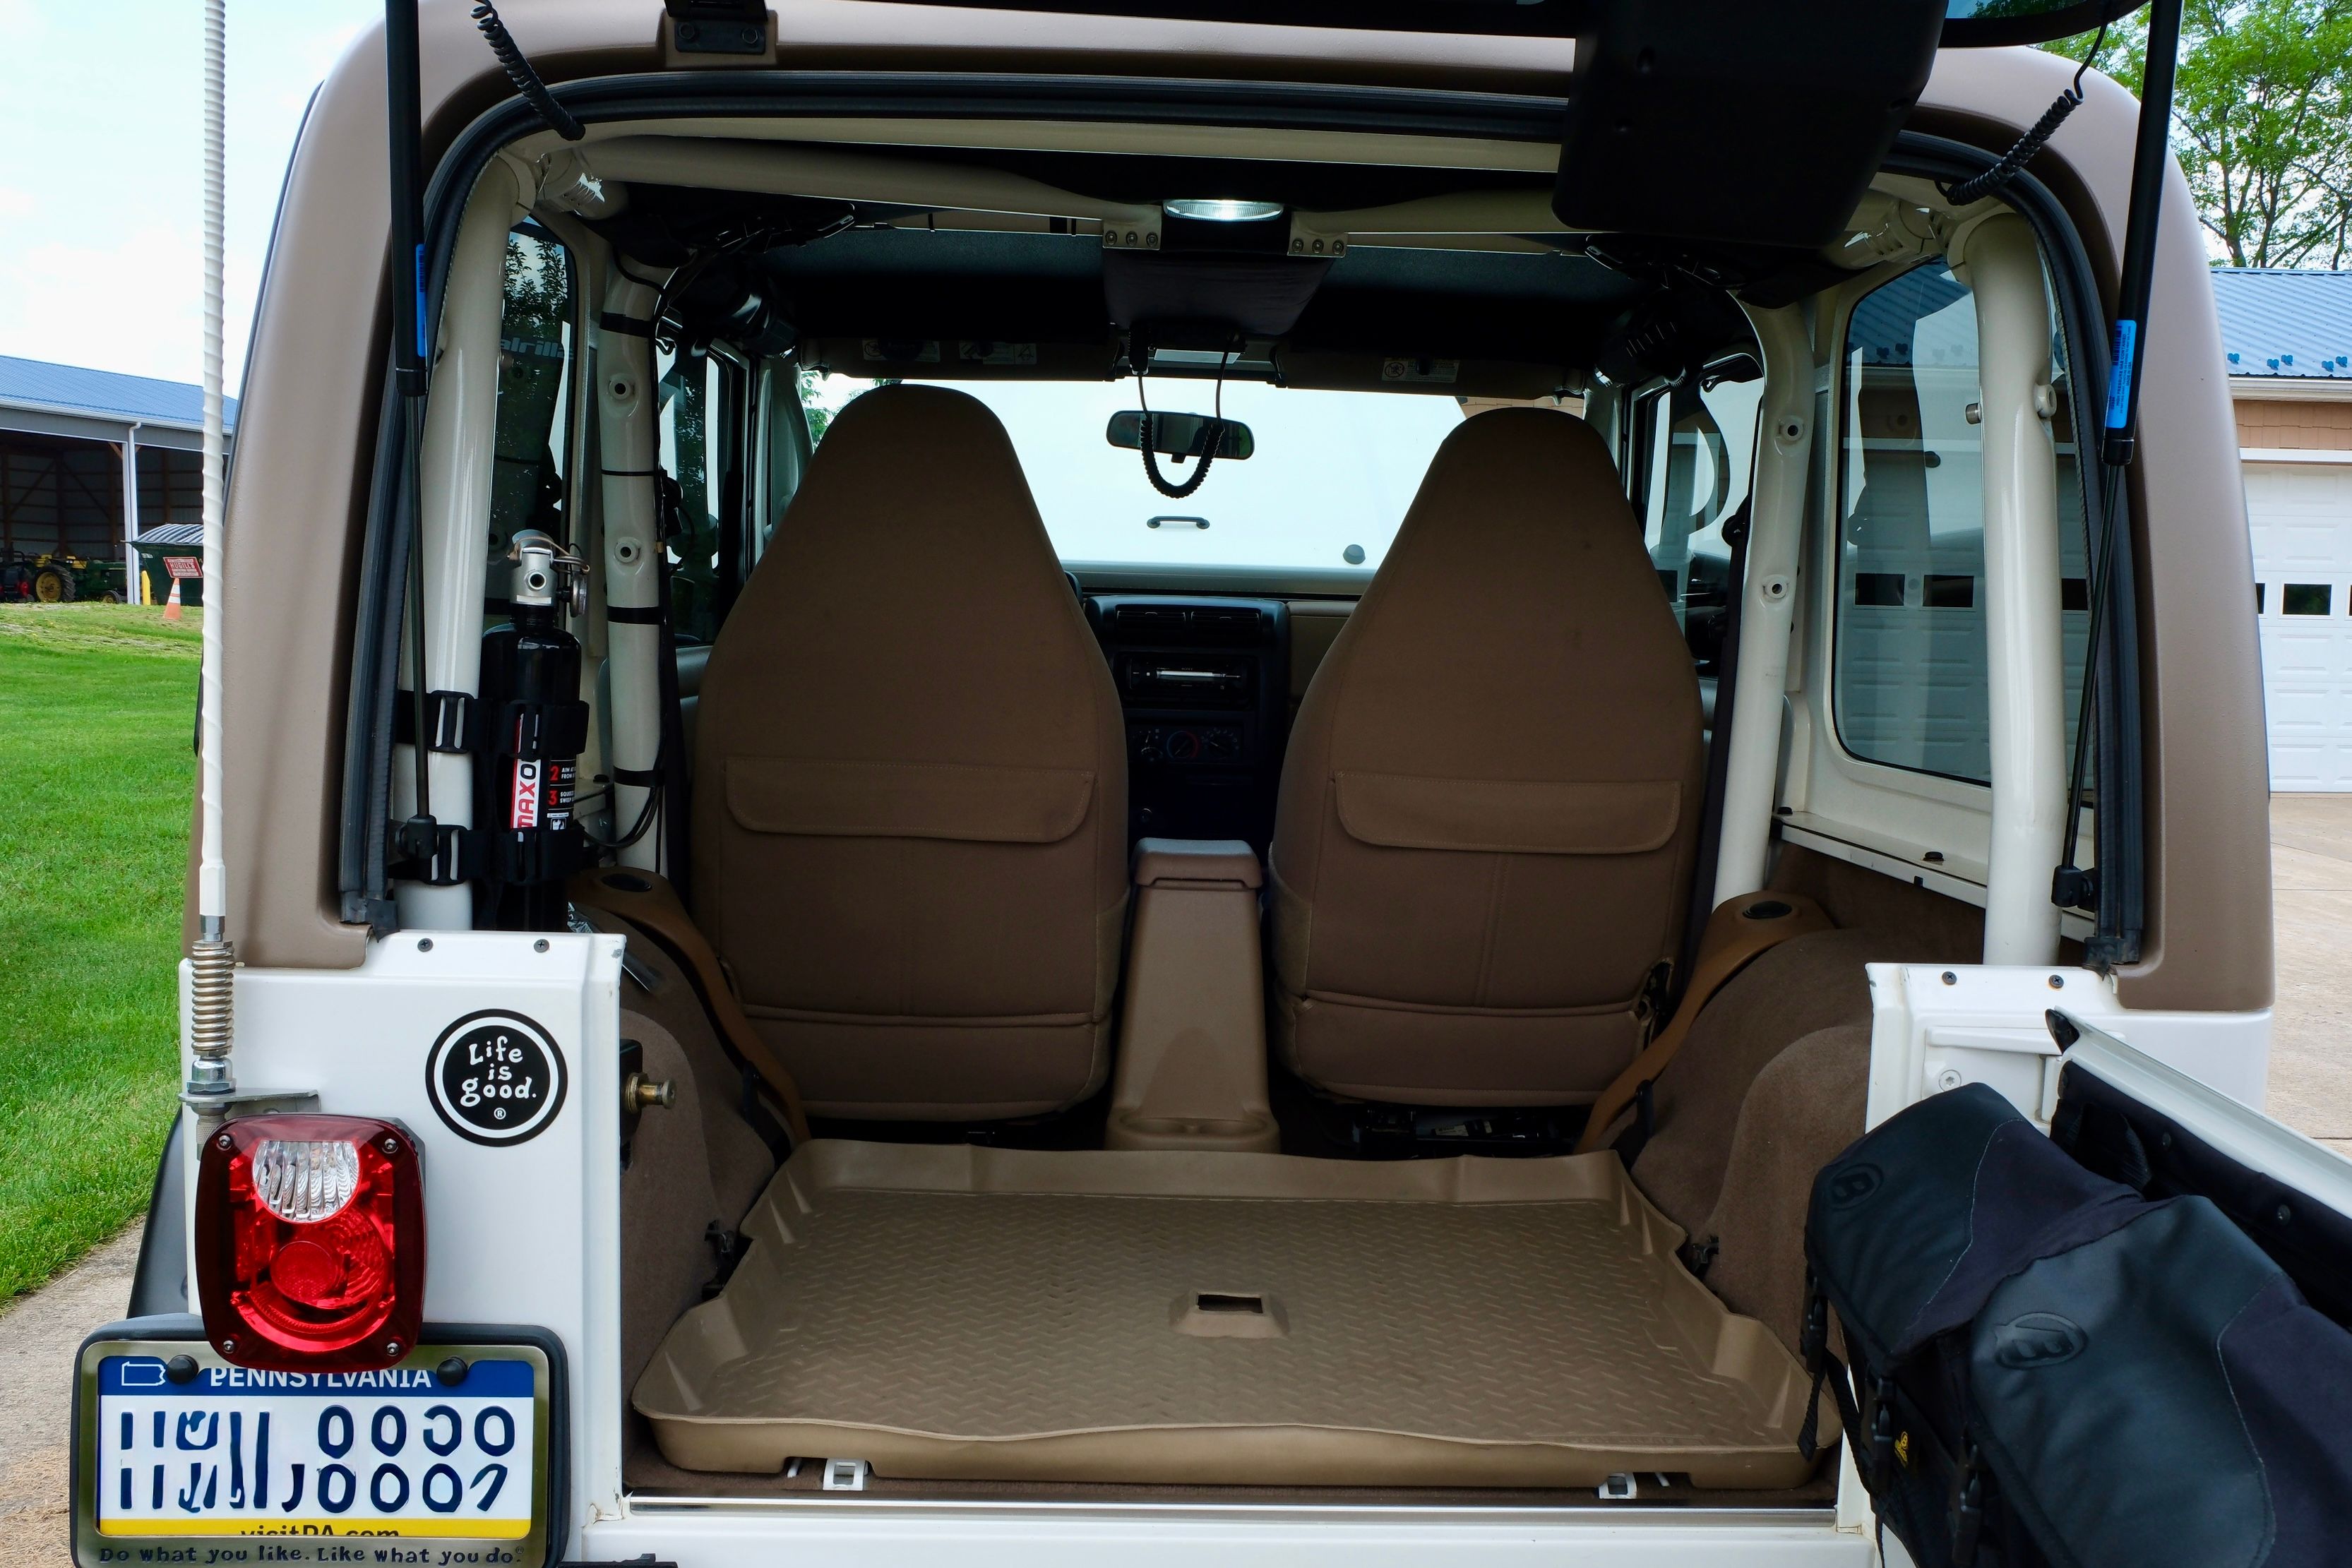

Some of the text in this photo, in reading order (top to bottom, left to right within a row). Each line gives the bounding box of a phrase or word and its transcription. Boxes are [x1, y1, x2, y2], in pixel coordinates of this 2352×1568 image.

[550, 765, 559, 781] 2
[549, 790, 557, 805] 3
[469, 1036, 523, 1065] Life
[488, 1063, 512, 1080] is
[460, 1077, 537, 1107] good.
[210, 1368, 431, 1387] PENNSYLVANIA
[241, 1525, 399, 1536] visitPAcom
[100, 1548, 129, 1562] Do
[141, 1546, 197, 1562] what
[205, 1550, 247, 1564] you
[259, 1545, 309, 1562] like.
[318, 1546, 364, 1562] Like
[374, 1548, 429, 1564] what
[438, 1550, 479, 1566] you
